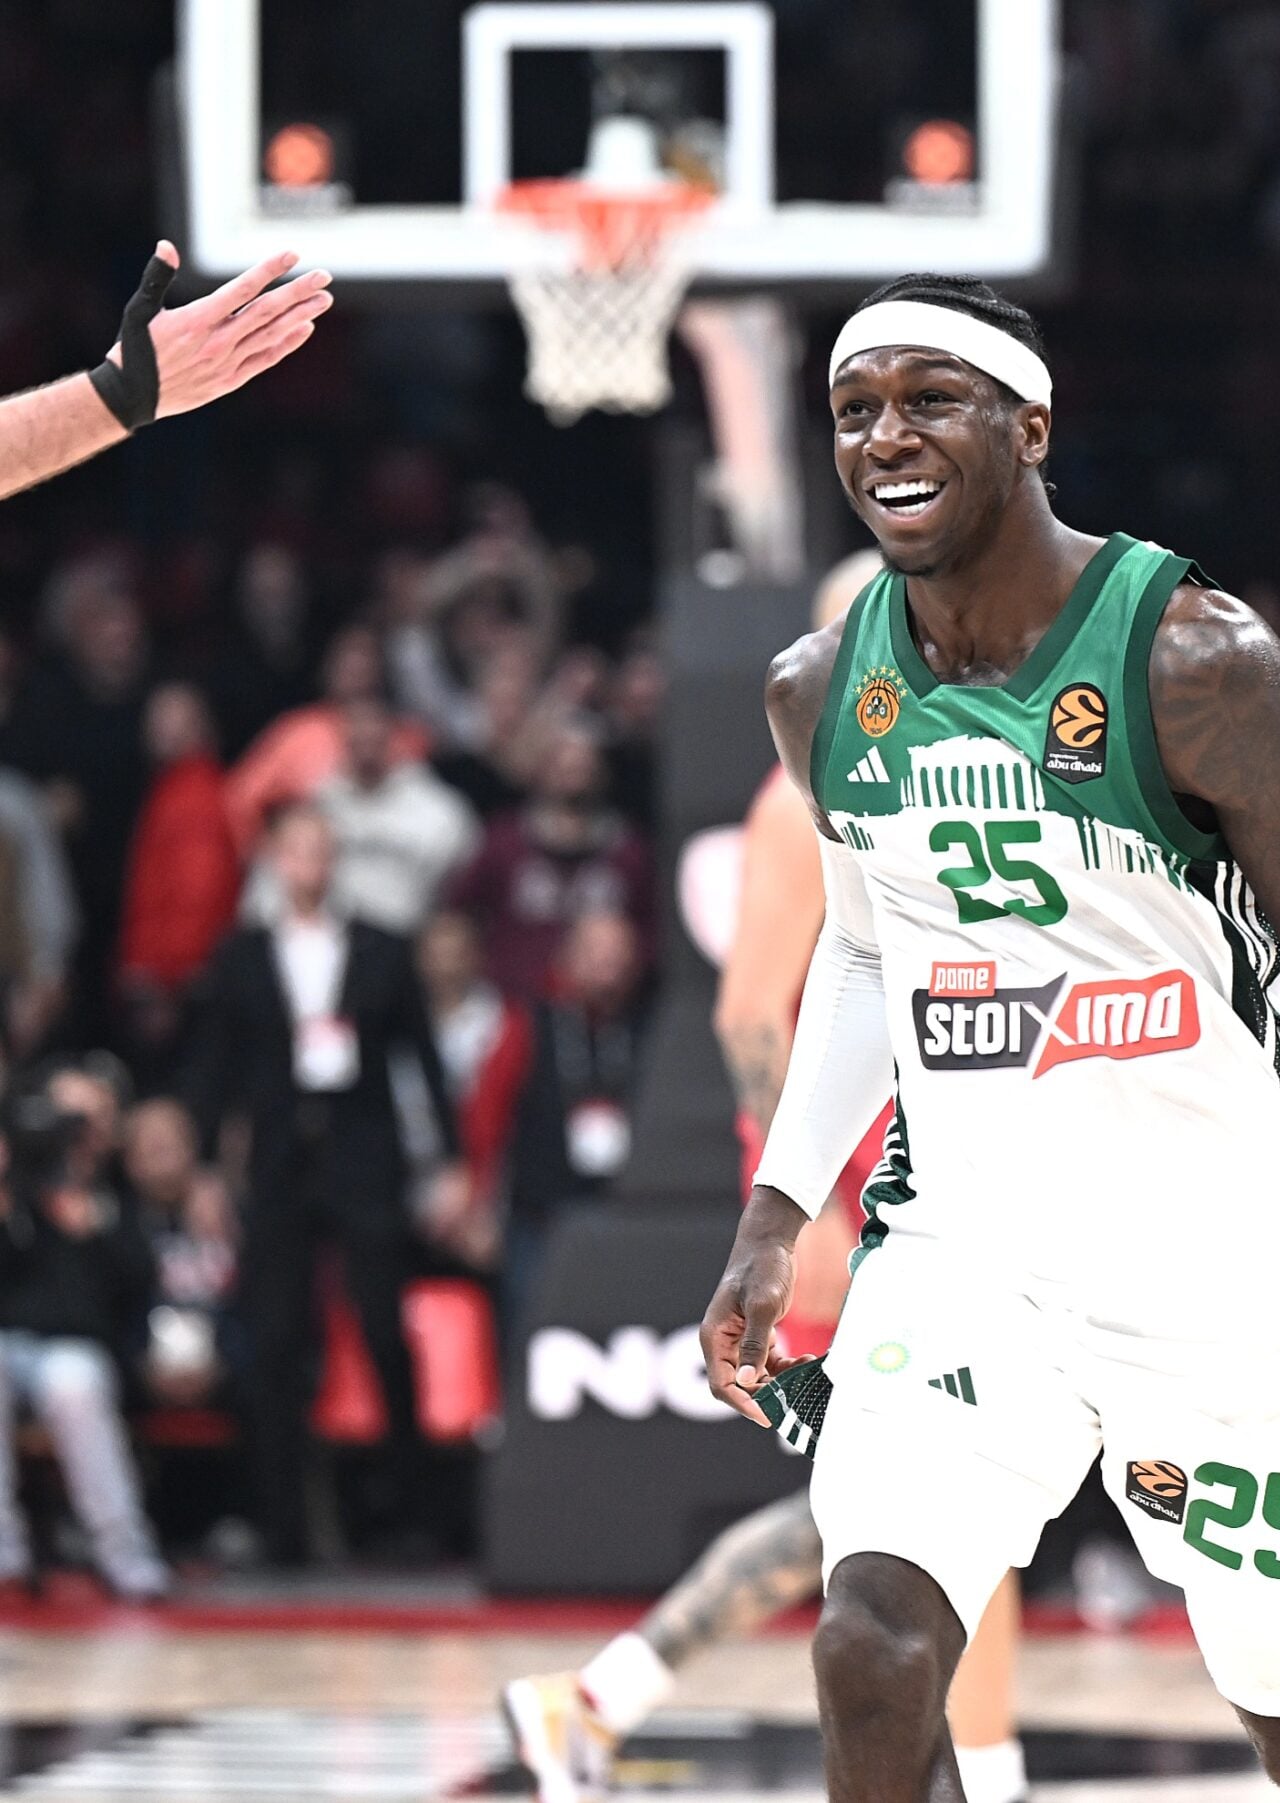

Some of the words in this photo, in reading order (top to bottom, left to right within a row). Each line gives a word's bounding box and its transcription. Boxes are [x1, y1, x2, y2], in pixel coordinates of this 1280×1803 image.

[1047, 759, 1069, 770] abu
[1070, 761, 1102, 773] dhabi
[929, 821, 1069, 927] 25
